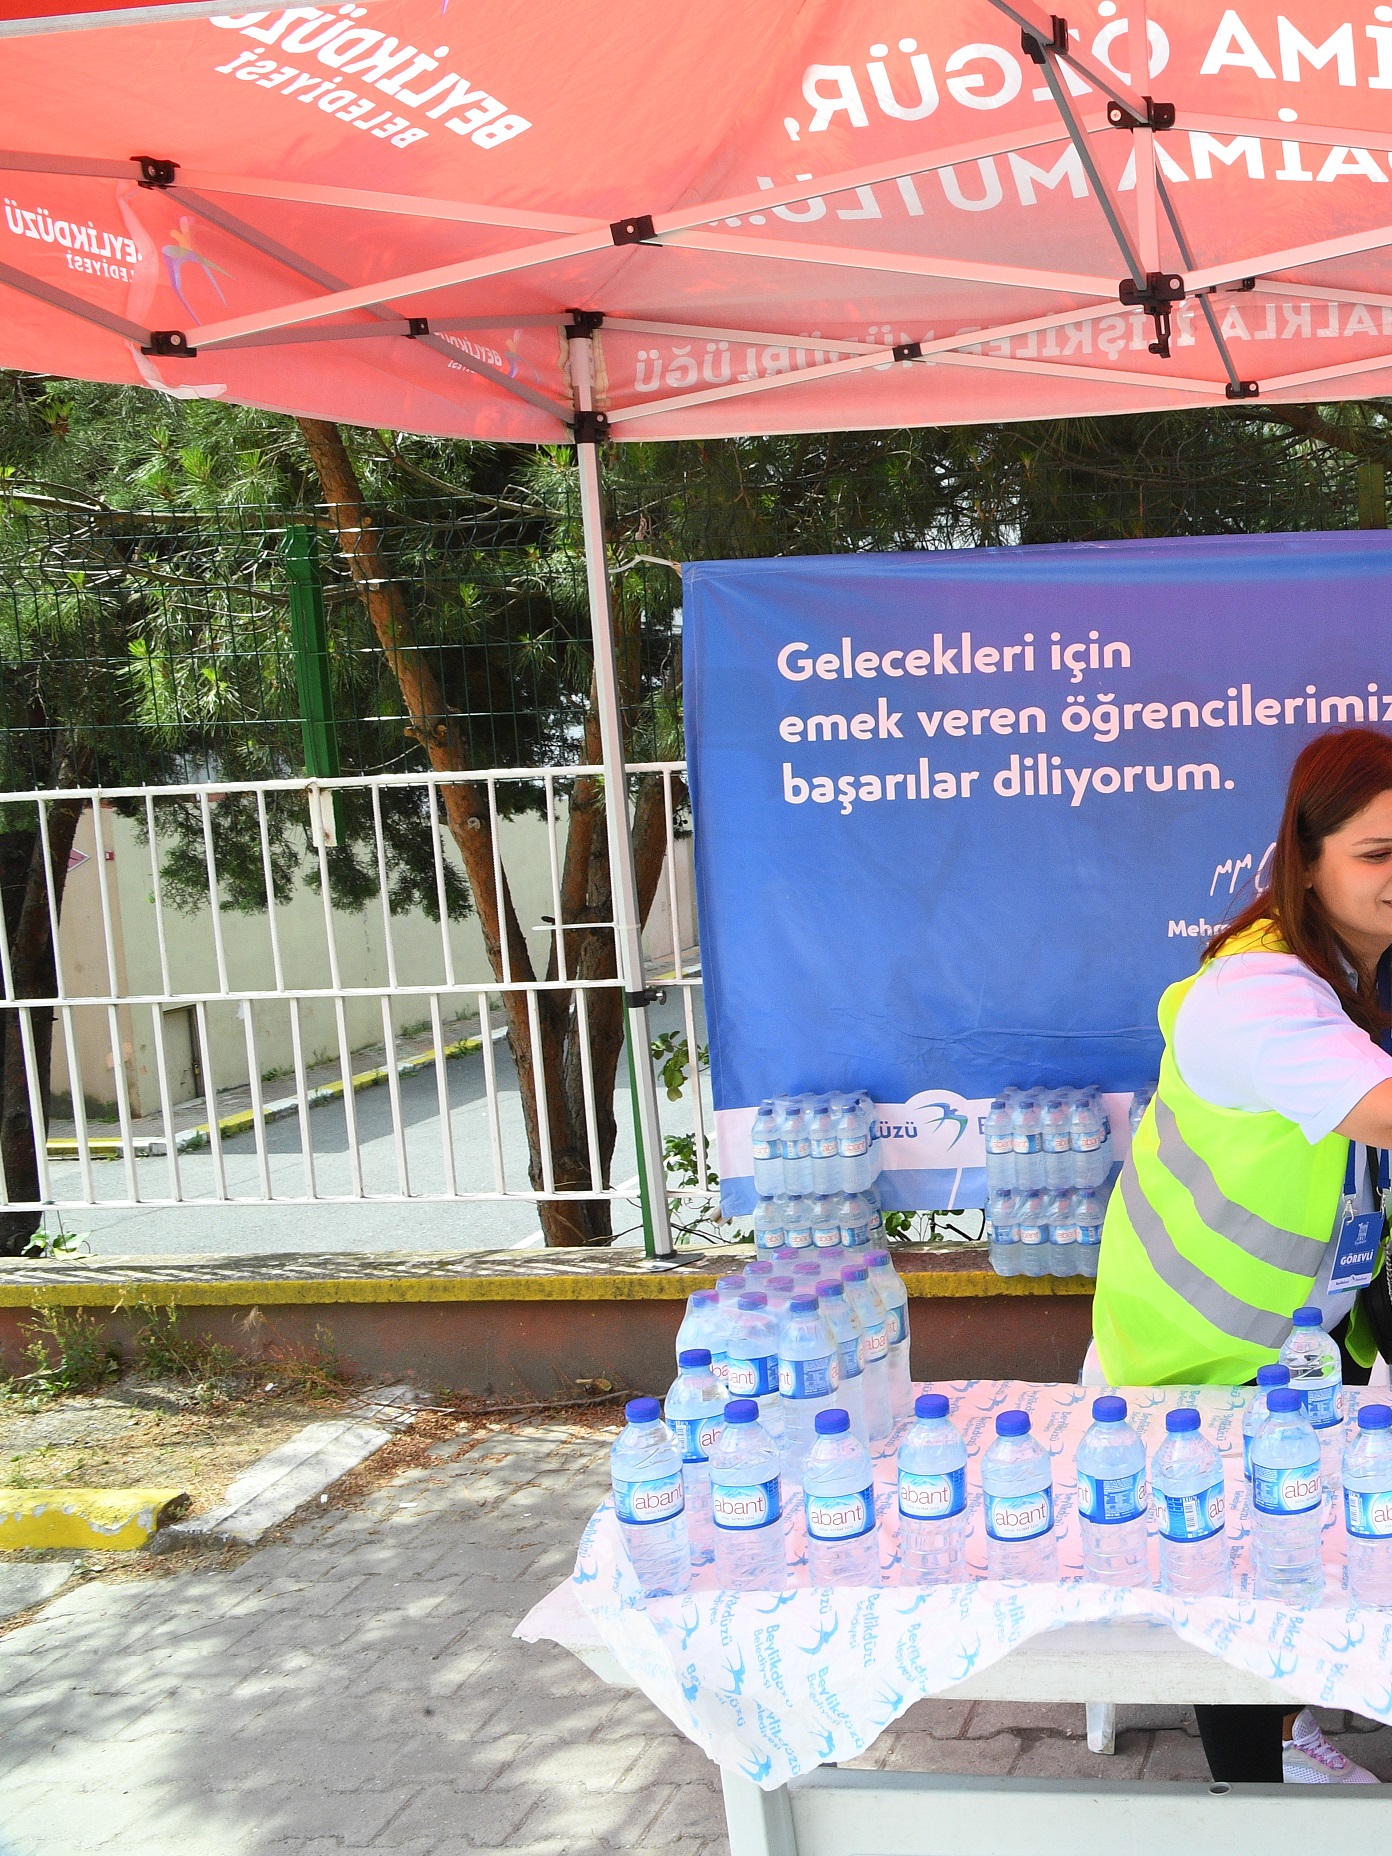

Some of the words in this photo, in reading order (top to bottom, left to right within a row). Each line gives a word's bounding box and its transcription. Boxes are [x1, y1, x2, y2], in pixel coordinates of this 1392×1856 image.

[776, 631, 1035, 682] Gelecekleri
[1051, 630, 1132, 683] için
[778, 697, 904, 743] emek
[917, 705, 1046, 737] veren
[782, 757, 980, 815] başarılar
[993, 753, 1235, 807] diliyorum.
[1340, 1248, 1374, 1266] GÖREVLİ
[635, 1483, 683, 1510] abant
[714, 1496, 764, 1515] abant
[900, 1485, 949, 1504] abant
[811, 1505, 862, 1526] abant
[995, 1503, 1046, 1526] abant
